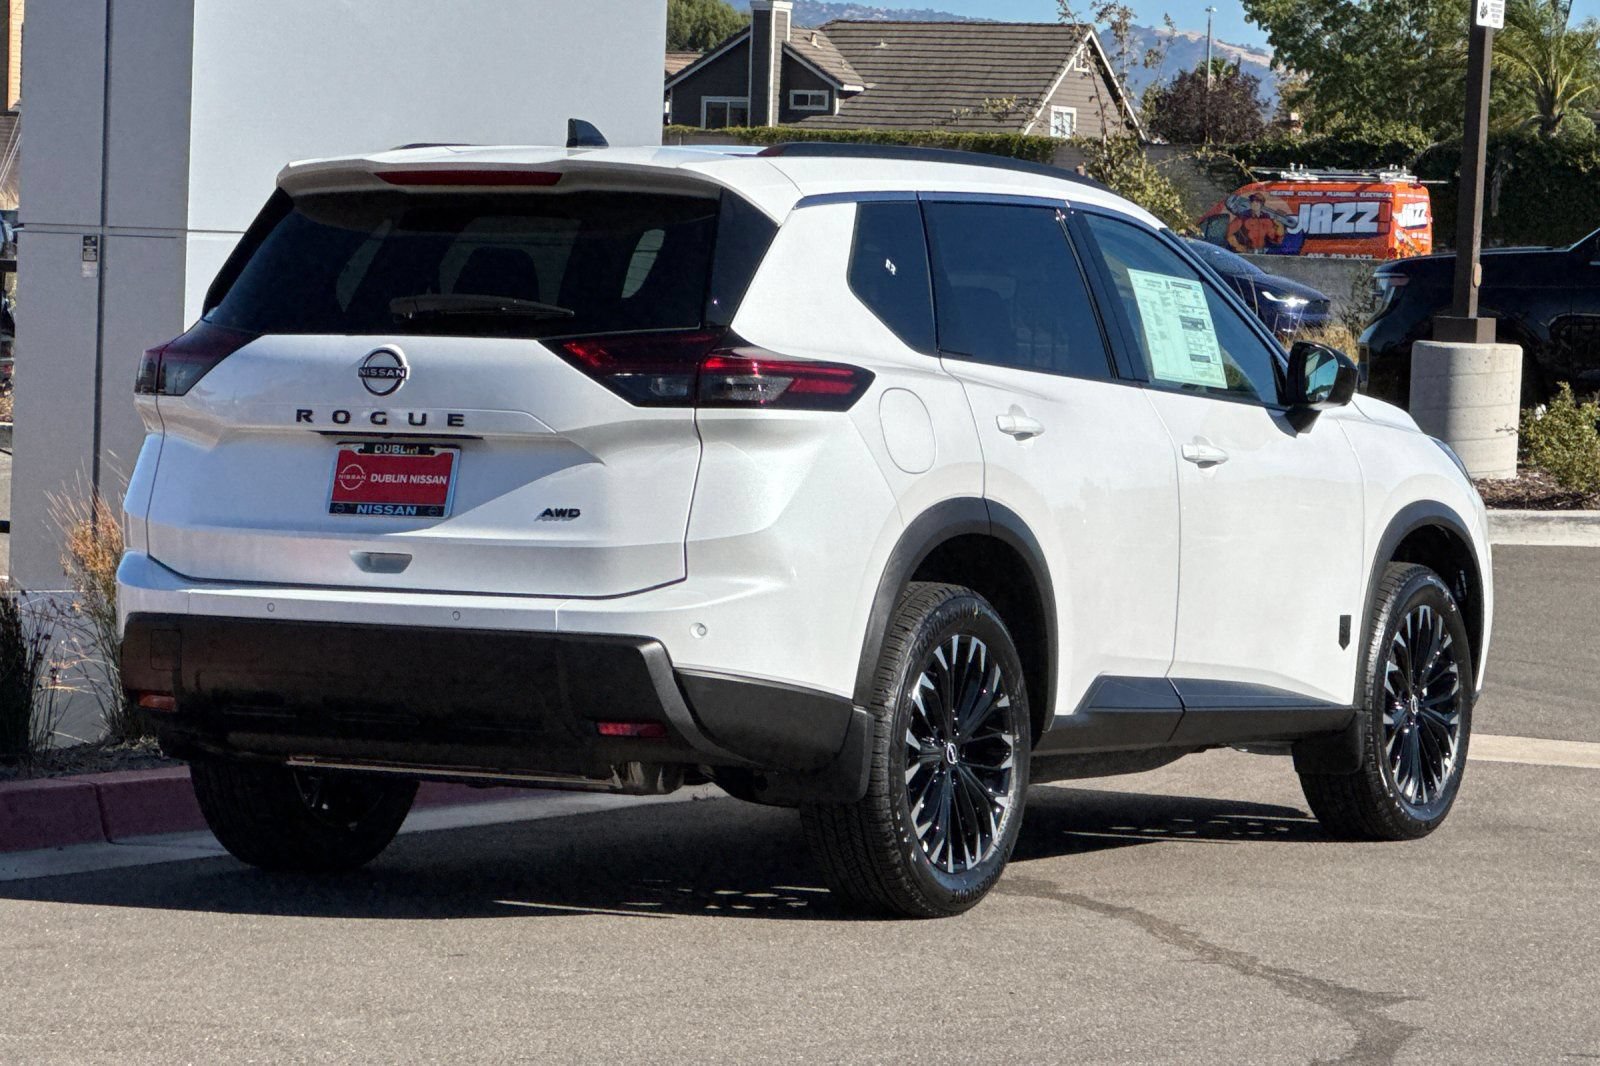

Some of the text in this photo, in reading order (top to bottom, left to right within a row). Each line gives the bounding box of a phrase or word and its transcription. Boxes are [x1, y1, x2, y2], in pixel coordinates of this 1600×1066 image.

[1287, 202, 1380, 235] JAZZ
[1394, 202, 1428, 228] JAZZ
[358, 368, 405, 377] NISSAN
[296, 409, 465, 427] ROGUE
[370, 473, 448, 485] DUBLIN NISSAN
[356, 504, 418, 516] NISSAN
[541, 507, 581, 519] AWD
